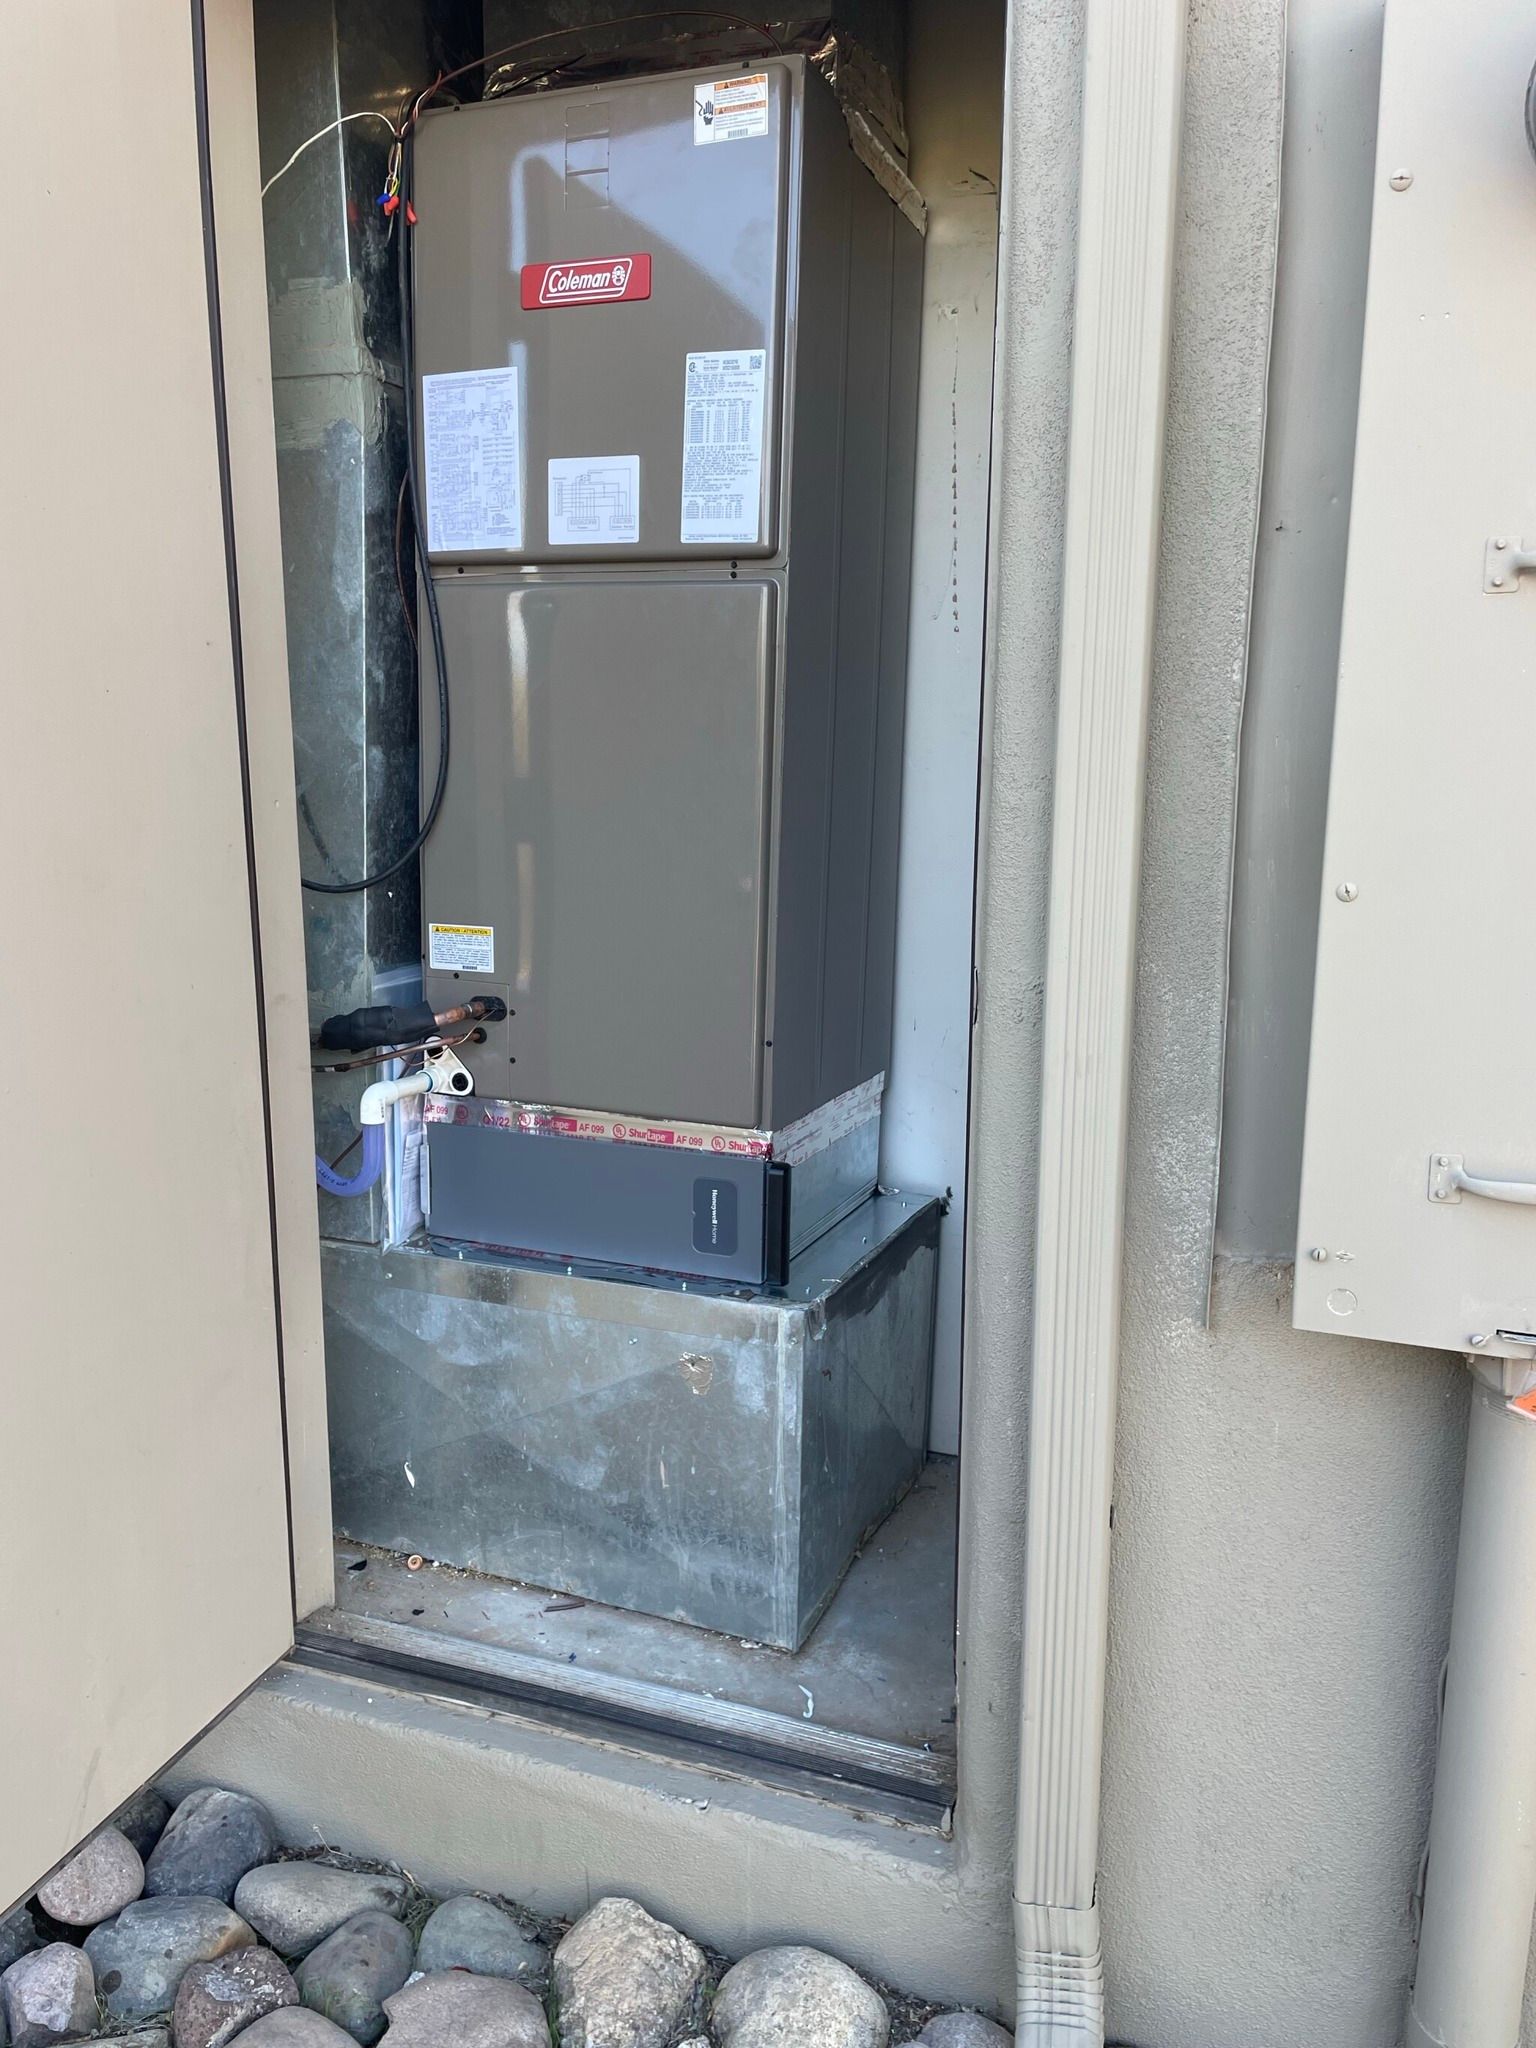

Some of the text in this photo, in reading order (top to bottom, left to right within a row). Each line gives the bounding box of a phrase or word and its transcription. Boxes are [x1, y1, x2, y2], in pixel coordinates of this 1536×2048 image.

[548, 269, 611, 293] Coleman
[436, 1106, 449, 1115] 099
[579, 1123, 590, 1132] AF
[591, 1124, 605, 1134] 099
[629, 1128, 666, 1142] Shurtape
[676, 1135, 688, 1144] AF
[688, 1136, 703, 1147] 099
